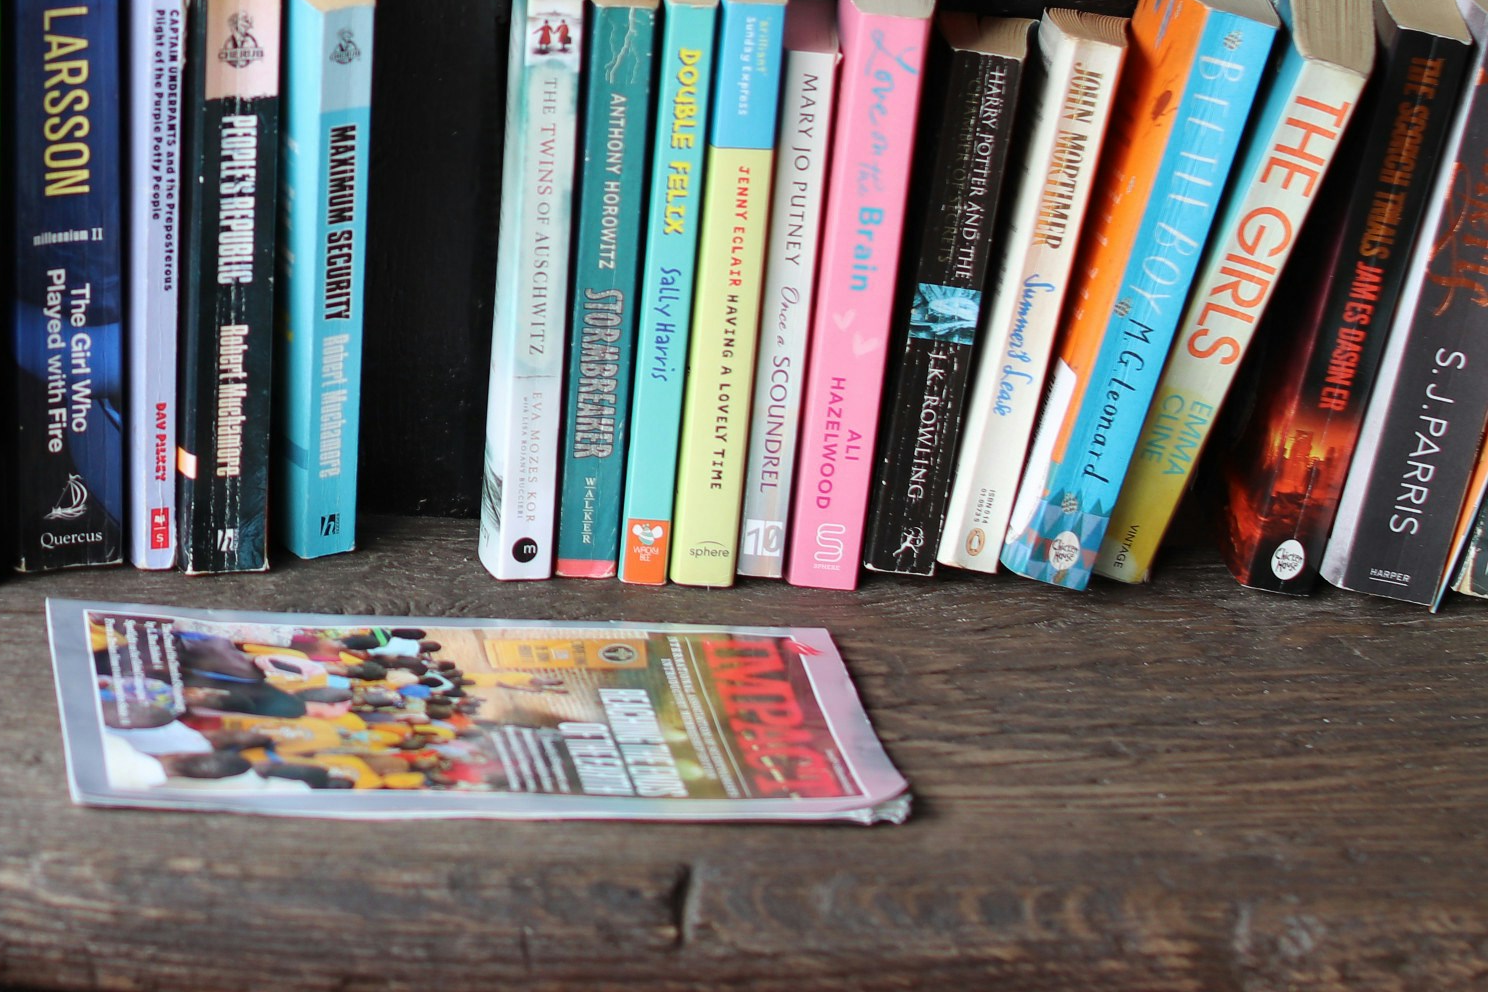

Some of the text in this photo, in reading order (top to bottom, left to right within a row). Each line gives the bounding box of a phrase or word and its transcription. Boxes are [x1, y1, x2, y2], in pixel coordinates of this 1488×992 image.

[43, 6, 91, 197] LARSSON
[151, 9, 167, 221] Plight of the Purple Potty People
[162, 9, 180, 292] CAPTAIN UNDERPANTS and the Preposterous
[662, 47, 703, 236] DOUBLE FELIX
[1065, 61, 1104, 124] JOHN
[1359, 57, 1446, 261] THE SCORCH TRIALS
[33, 229, 89, 246] millennium
[217, 114, 258, 285] PEOPLE'S REPUBLIC
[323, 124, 357, 321] MAXIMUM SECURITY
[528, 77, 558, 356] THE TWINS OF AUSCHWITZ
[598, 92, 628, 270] ANTHONY HOROWITZ
[784, 72, 819, 266] MARY JO PUTNEY
[954, 70, 1007, 280] HARRY POTTER AND THE
[1031, 130, 1089, 251] MORTIMER
[1184, 95, 1354, 366] THE GIRLS
[44, 268, 70, 454] Played with Fire
[70, 282, 92, 434] The Girl Who
[573, 287, 625, 460] STORMBREAKER
[650, 267, 683, 382] Sally Harris
[709, 165, 752, 491] JENNY ECLAIR HAVING A LOVELY TIME
[759, 285, 801, 494] Once a SCOUNDREL
[1318, 261, 1385, 411] JAMES DASHNER
[1421, 383, 1455, 410] J.
[1431, 347, 1467, 375] S.
[154, 403, 167, 482] DAV PILKEY
[216, 324, 250, 478] Robert Muchamore
[318, 334, 351, 480] Robert Muchamore
[516, 396, 531, 519] with LISA ROJANY BUCCIERI
[524, 392, 544, 522] EVA MOZES KOR
[814, 376, 847, 509] HAZELWOOD
[844, 428, 863, 461] ALI
[905, 351, 949, 500] J.K. ROWLING
[1140, 393, 1186, 465] CLINE
[1162, 399, 1213, 477] EMMA
[1389, 414, 1449, 536] PARRIS
[41, 531, 103, 549] Quercus
[689, 546, 730, 558] sphere
[1113, 524, 1140, 570] VINTAGE
[1369, 567, 1411, 583] HARPER
[703, 638, 844, 796] IMPACT
